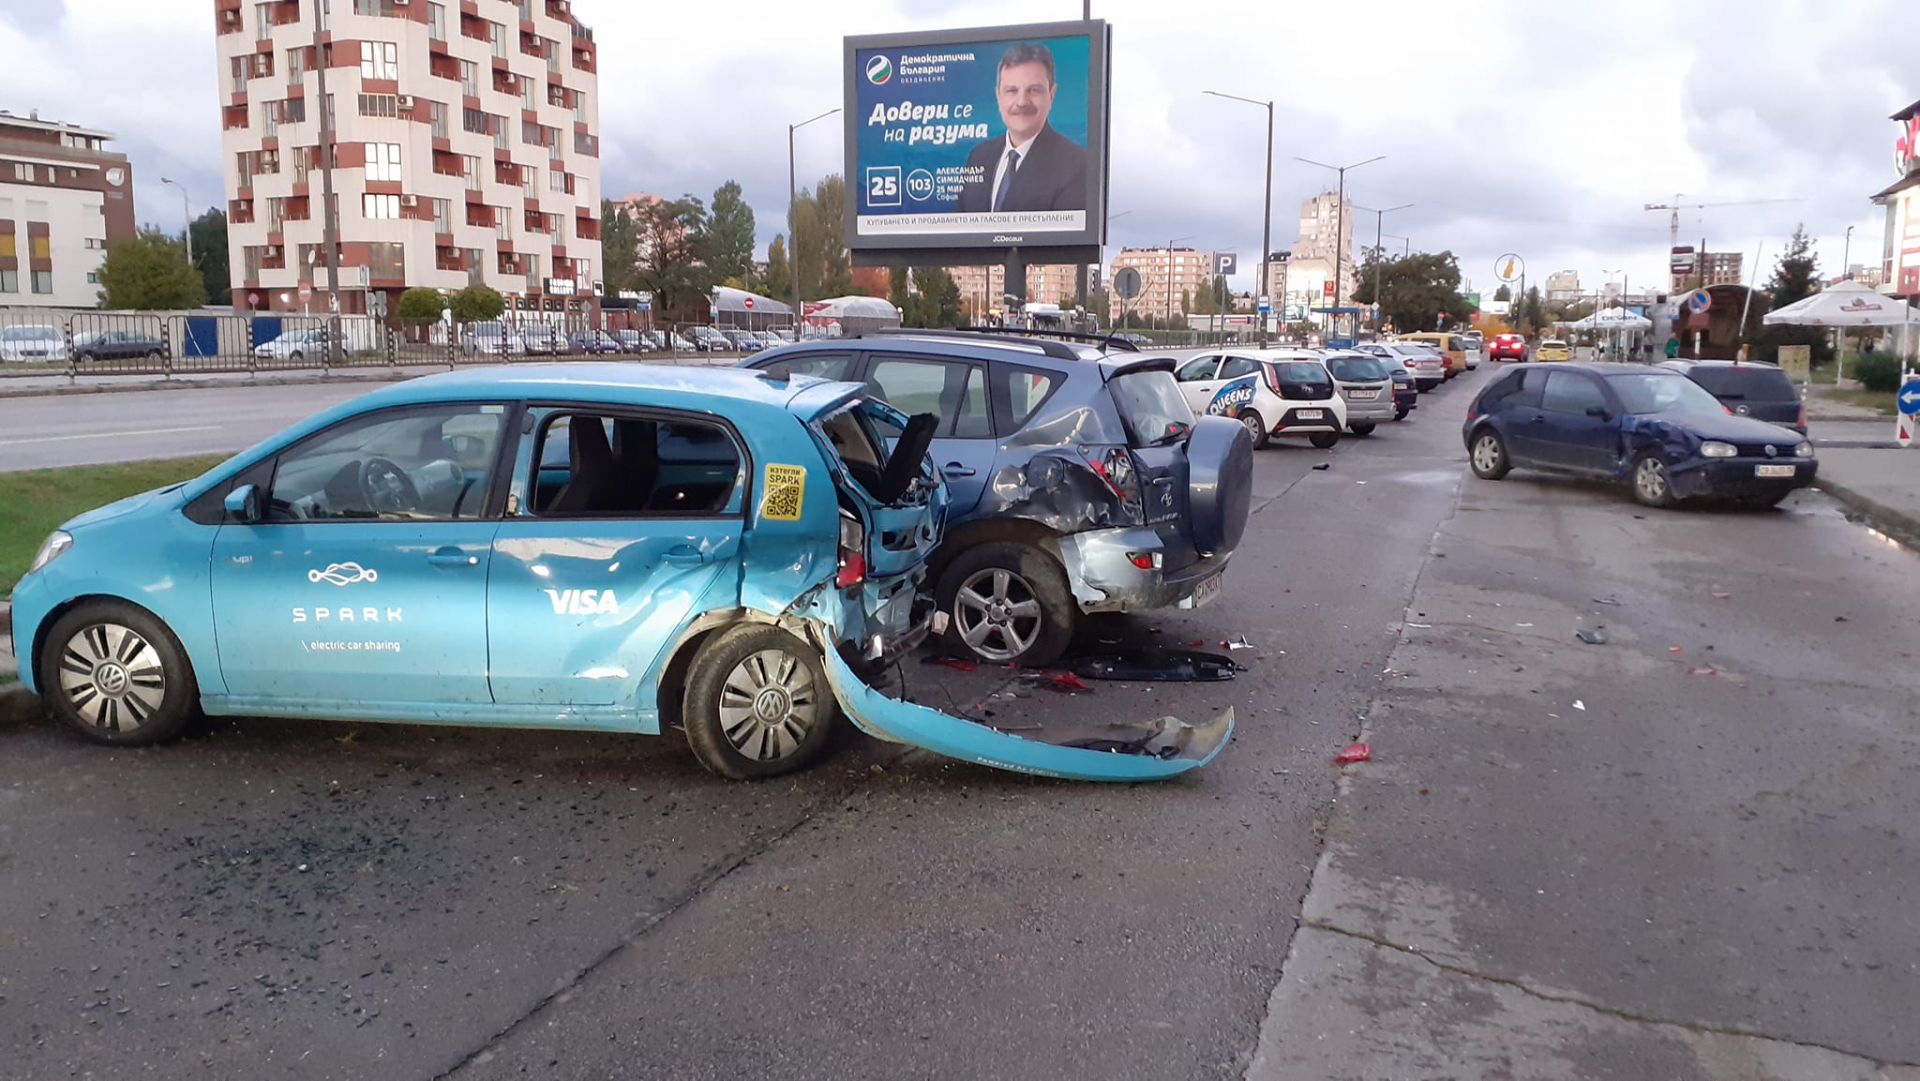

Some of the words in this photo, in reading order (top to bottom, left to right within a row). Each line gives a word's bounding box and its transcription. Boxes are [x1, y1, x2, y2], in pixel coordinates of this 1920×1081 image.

[900, 53, 975, 65] Демократична
[900, 65, 946, 75] България
[868, 101, 949, 126] Довери
[953, 104, 973, 118] се
[884, 128, 905, 142] на
[908, 123, 989, 145] разума
[936, 166, 985, 175] АЛЕКСАНДЪР
[871, 176, 897, 196] 25
[909, 178, 931, 191] 103
[936, 175, 984, 185] СИМИДЧИЕВ
[936, 185, 945, 193] 25
[947, 185, 964, 193] МИР
[936, 193, 958, 201] София
[866, 218, 910, 226] КУПУВАНЕТО
[911, 217, 917, 225] И
[918, 216, 969, 225] ПРОДАВАНЕТО
[980, 215, 1010, 223] ГЛАСОВЕ
[1019, 213, 1075, 222] ПРЕСТЪПЛЕНИЕ
[1219, 256, 1232, 273] P
[769, 474, 800, 485] SPARK
[543, 589, 619, 615] VISA
[292, 607, 403, 623] SPARK
[310, 640, 345, 651] electric
[347, 641, 362, 650] car
[364, 641, 401, 652] sharing
